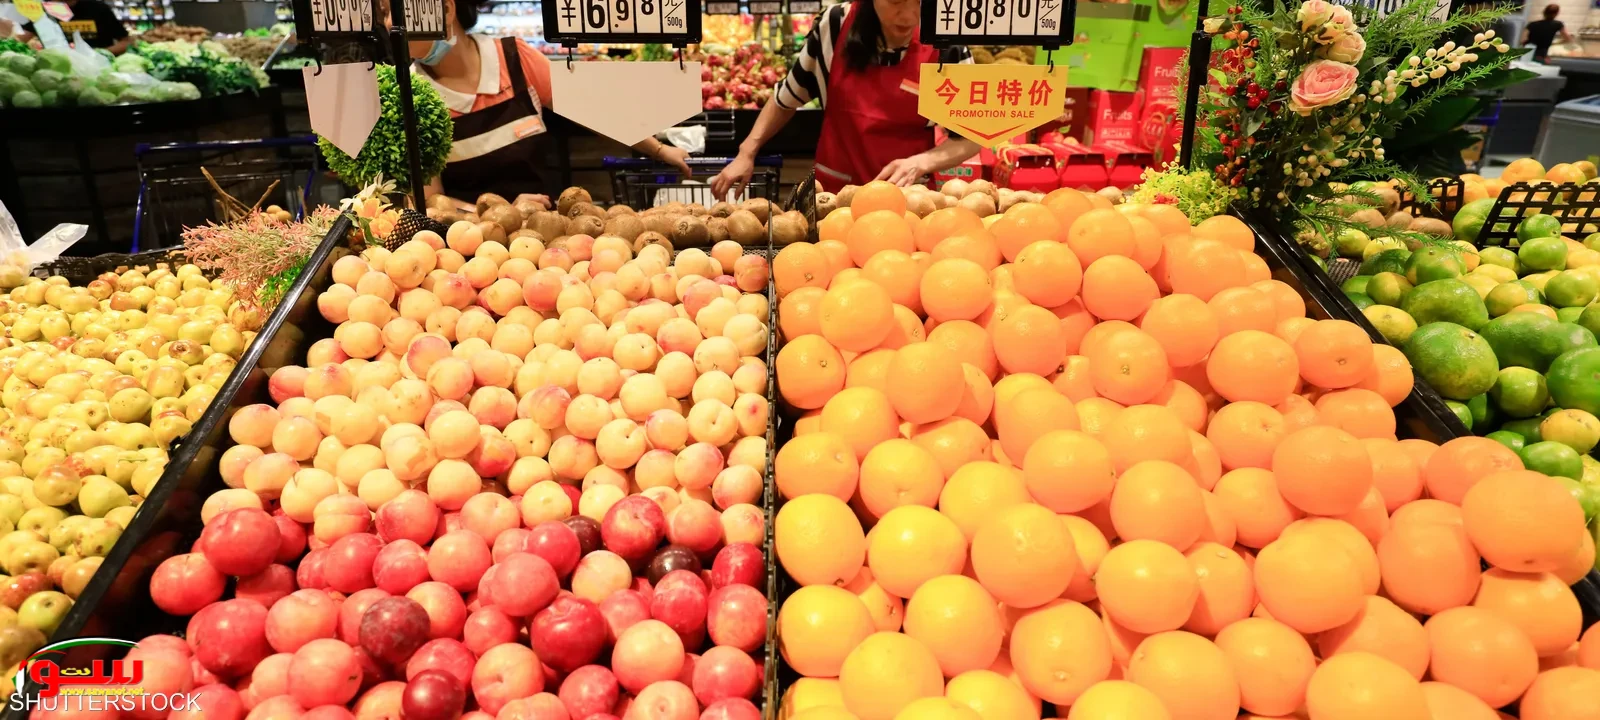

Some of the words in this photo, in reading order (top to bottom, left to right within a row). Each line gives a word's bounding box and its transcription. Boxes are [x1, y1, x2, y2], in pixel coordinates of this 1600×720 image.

[935, 78, 1053, 106] 今日特价
[949, 109, 1006, 118] PROMOTION
[1010, 110, 1035, 118] SALE
